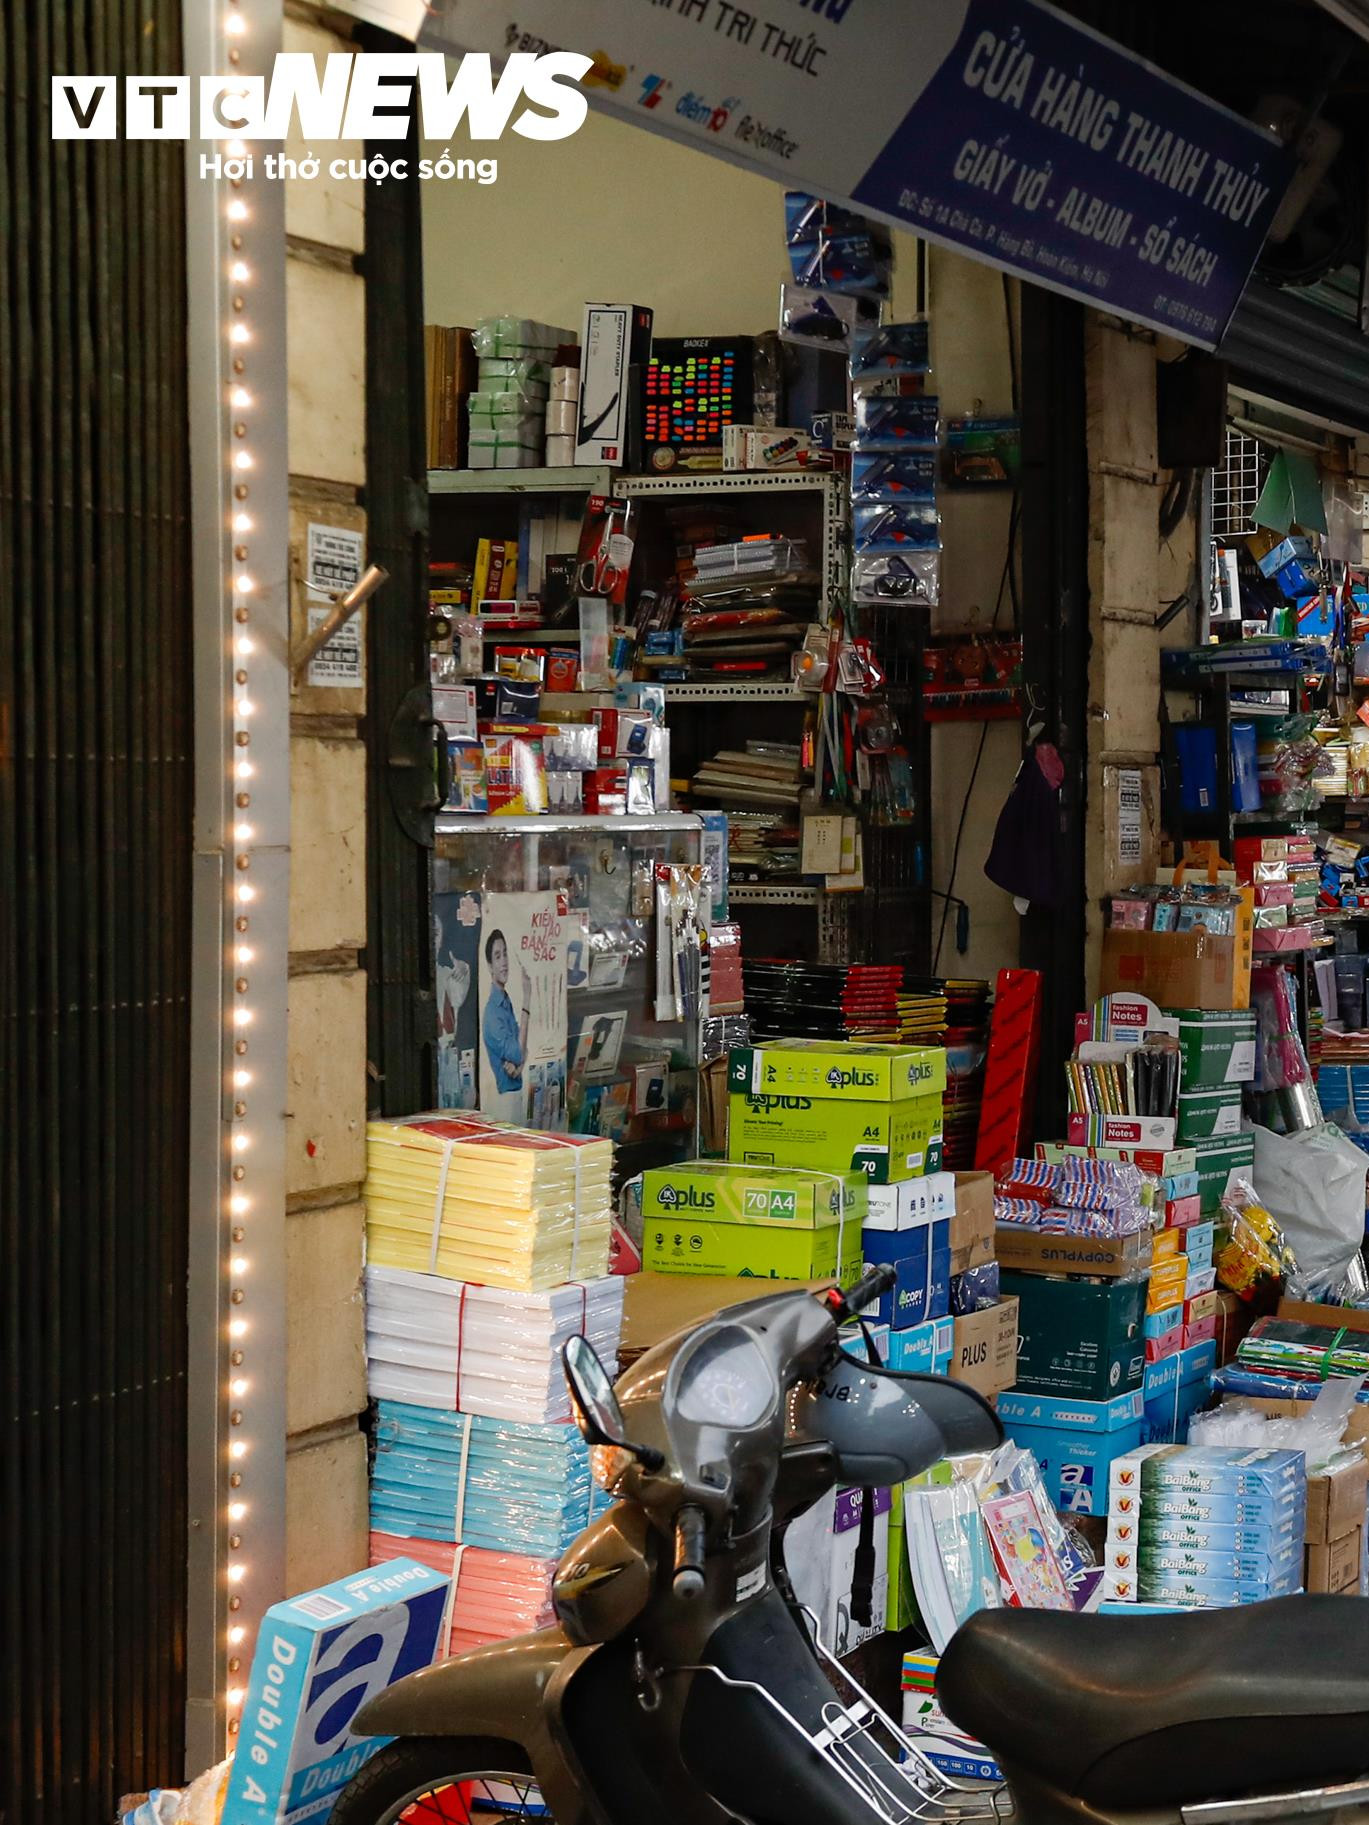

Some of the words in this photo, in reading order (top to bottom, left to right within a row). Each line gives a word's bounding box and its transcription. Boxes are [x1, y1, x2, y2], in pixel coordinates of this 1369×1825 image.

[714, 1, 758, 45] TRI
[760, 22, 828, 78] THỨC
[962, 25, 1036, 110] CỬA
[1029, 62, 1121, 152] HÀNG
[1116, 111, 1210, 199] THANH
[952, 133, 1017, 196] GIẤY
[1011, 160, 1054, 211] VỞ
[1055, 187, 1134, 250] ALBUM
[1138, 215, 1179, 266] SỔ
[1166, 232, 1220, 289] SÁCH
[531, 905, 555, 928] KIẾN
[1112, 1011, 1142, 1022] Notes
[733, 1063, 748, 1082] 70
[766, 1064, 778, 1084] A4
[1072, 1116, 1084, 1124] A5
[863, 1126, 881, 1138] A4
[1107, 1129, 1135, 1138] Notes
[862, 1160, 876, 1173] 70
[929, 1150, 939, 1164] 70
[746, 1192, 767, 1210] 70
[771, 1193, 795, 1212] A4
[1041, 1248, 1115, 1264] COPYPLUS
[905, 1288, 924, 1304] COPY
[961, 1342, 987, 1368] PLUS
[373, 1567, 431, 1596] Double
[251, 1634, 297, 1766] Double
[241, 1773, 268, 1807] A
